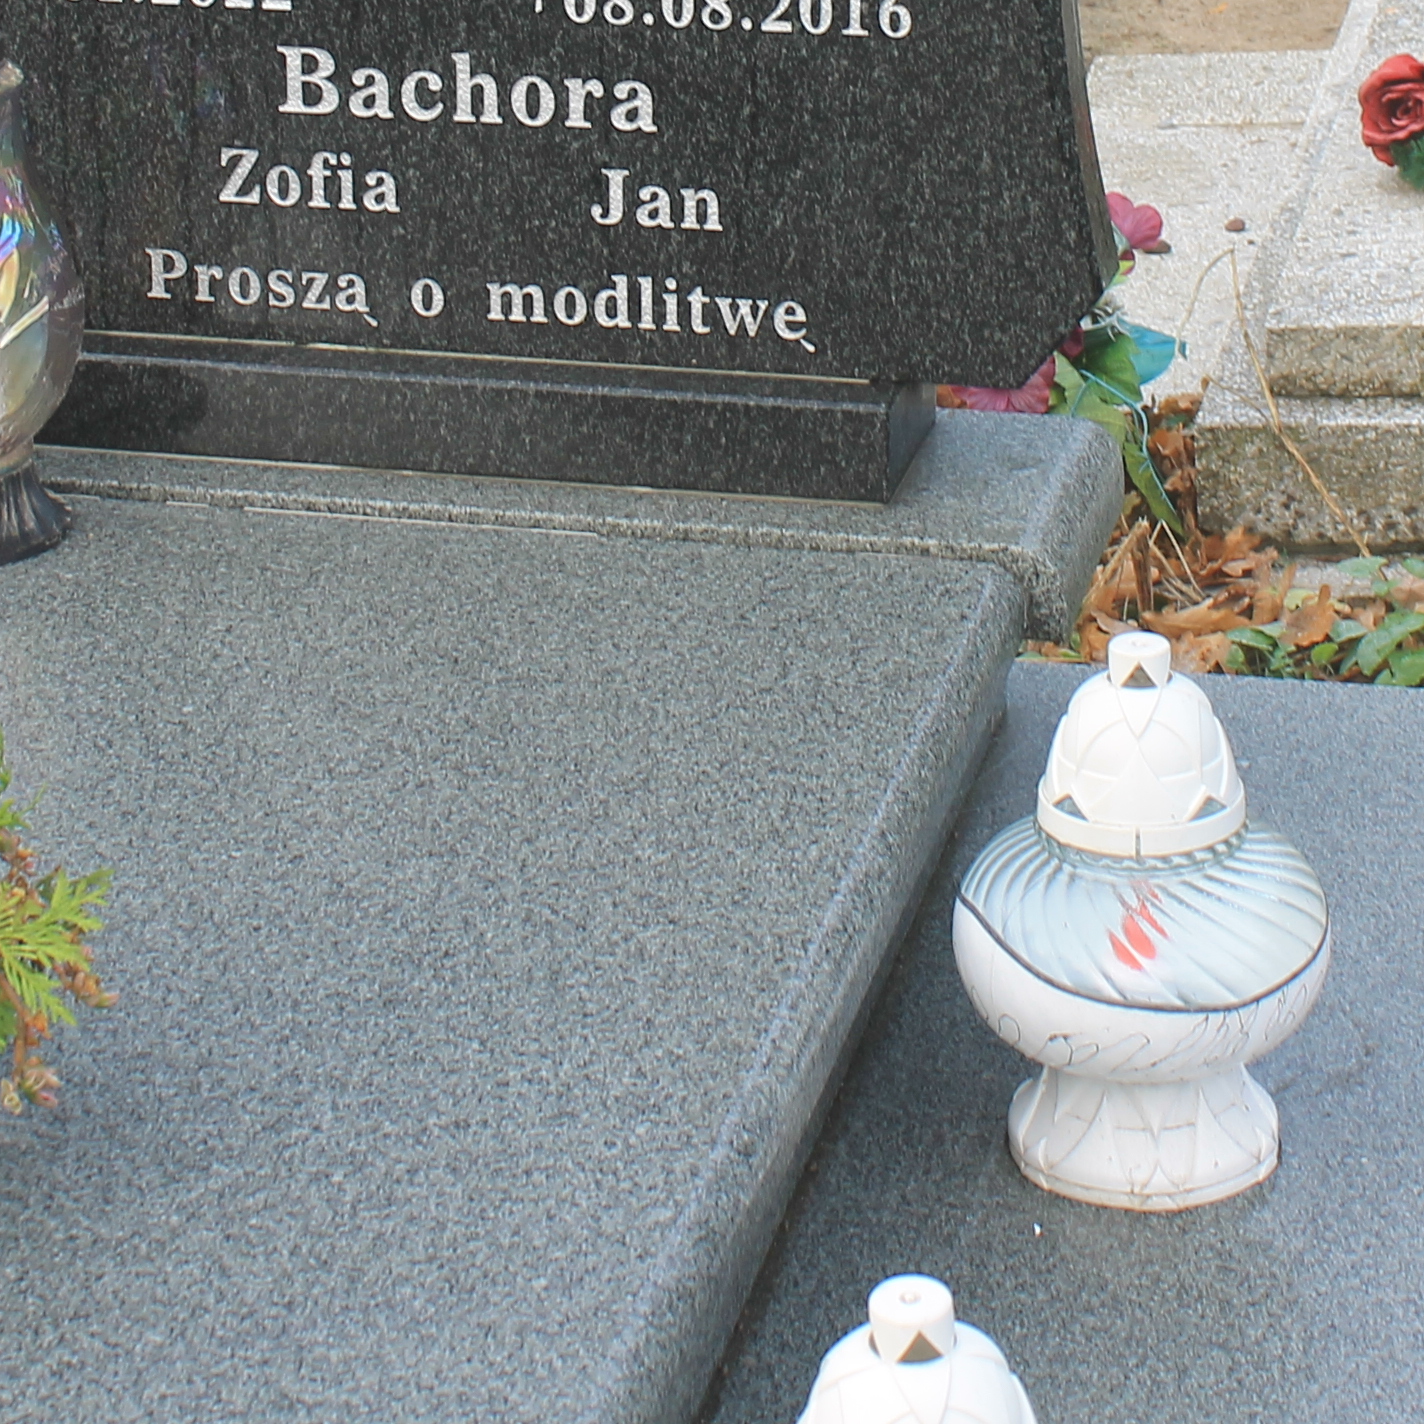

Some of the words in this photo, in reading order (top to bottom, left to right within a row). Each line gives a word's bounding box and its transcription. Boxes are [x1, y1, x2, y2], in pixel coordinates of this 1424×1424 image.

[276, 44, 659, 134] Bachora
[218, 147, 401, 214] Zofia
[589, 168, 724, 232] Jan
[145, 247, 378, 327] Proszą
[409, 277, 446, 318] o
[486, 273, 816, 354] modlitwę
